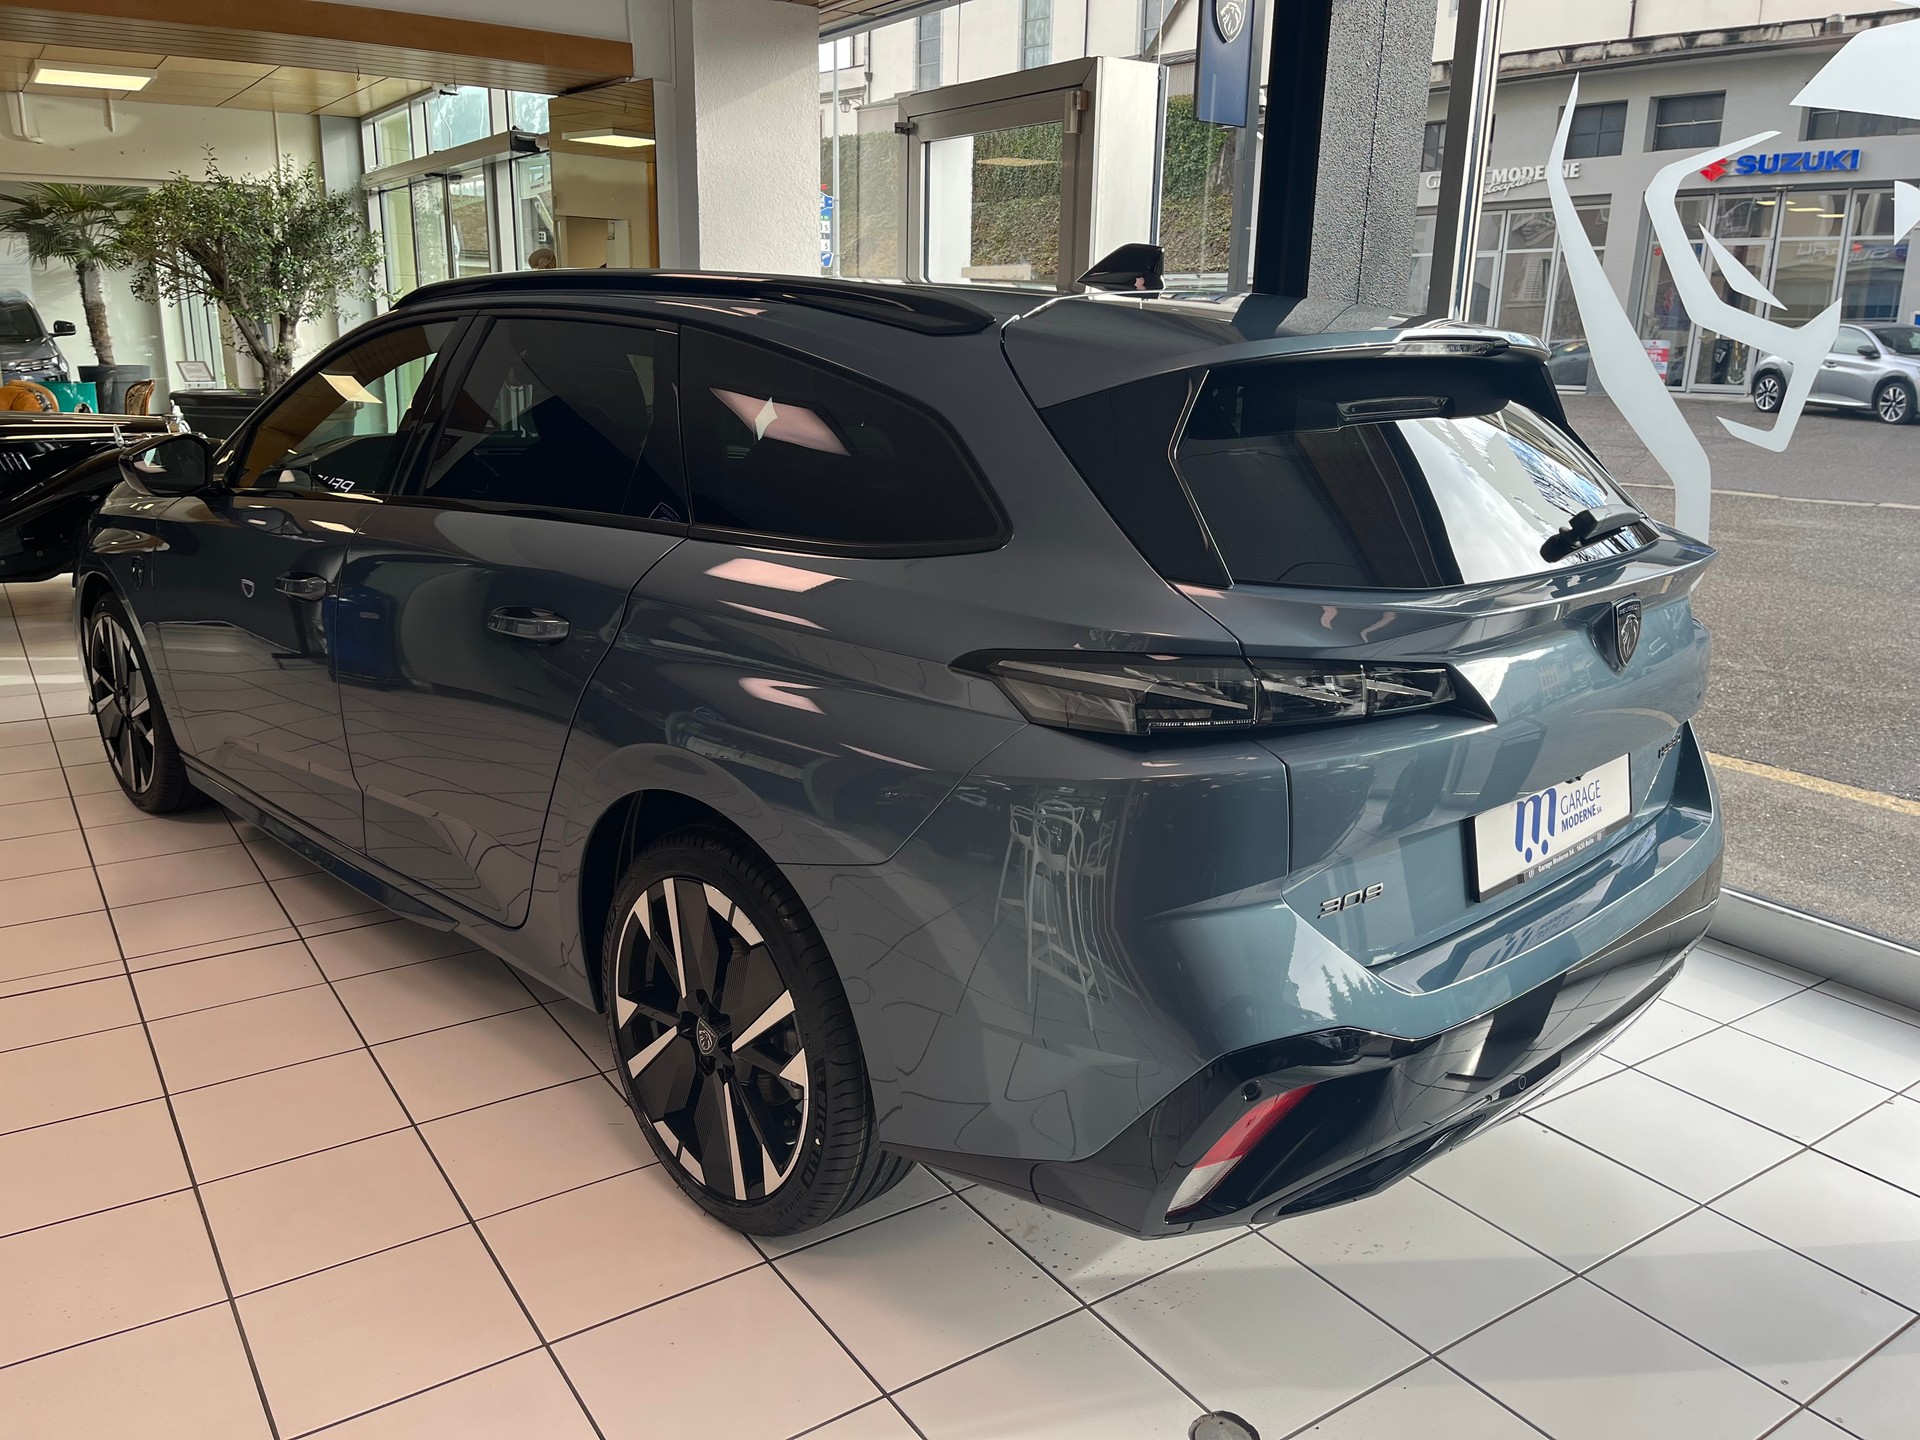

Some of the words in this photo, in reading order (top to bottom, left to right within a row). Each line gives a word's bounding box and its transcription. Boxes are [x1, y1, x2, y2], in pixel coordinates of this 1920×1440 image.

[1735, 149, 1861, 175] SUZUKI
[1560, 779, 1601, 816] GARAGE
[1561, 804, 1597, 832] MODERNE
[1537, 861, 1553, 873] Garage
[1553, 852, 1569, 864] Moderne
[1569, 848, 1575, 856] SA
[1317, 882, 1384, 919] 308
